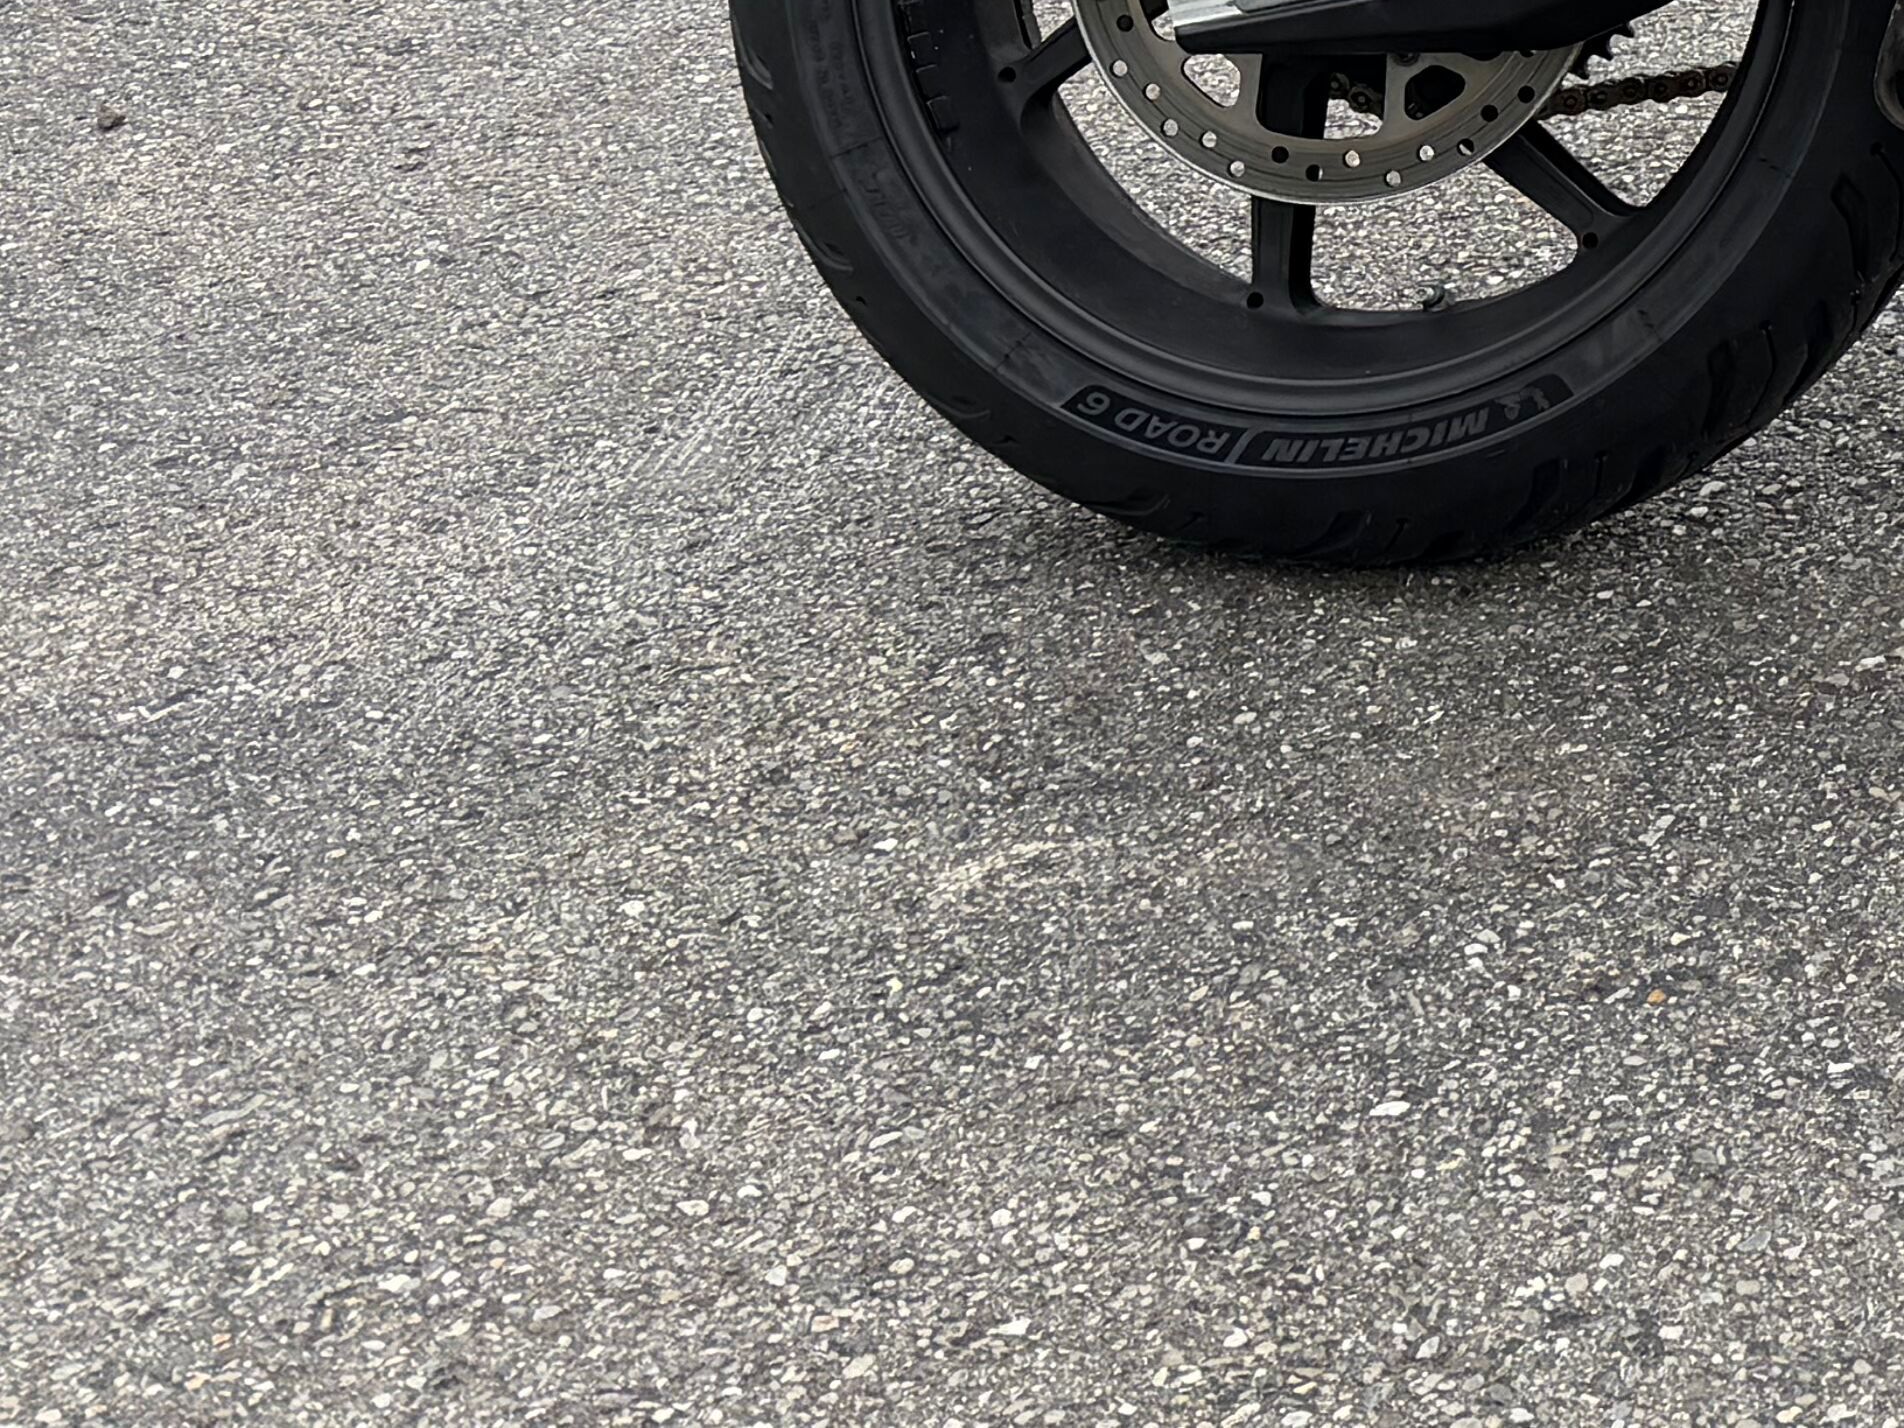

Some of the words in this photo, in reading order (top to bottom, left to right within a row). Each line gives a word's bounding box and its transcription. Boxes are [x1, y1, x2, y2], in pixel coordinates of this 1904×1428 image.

[1074, 388, 1111, 416] 6
[1112, 406, 1230, 454] ROAD
[1258, 406, 1490, 464] MICHELIN
